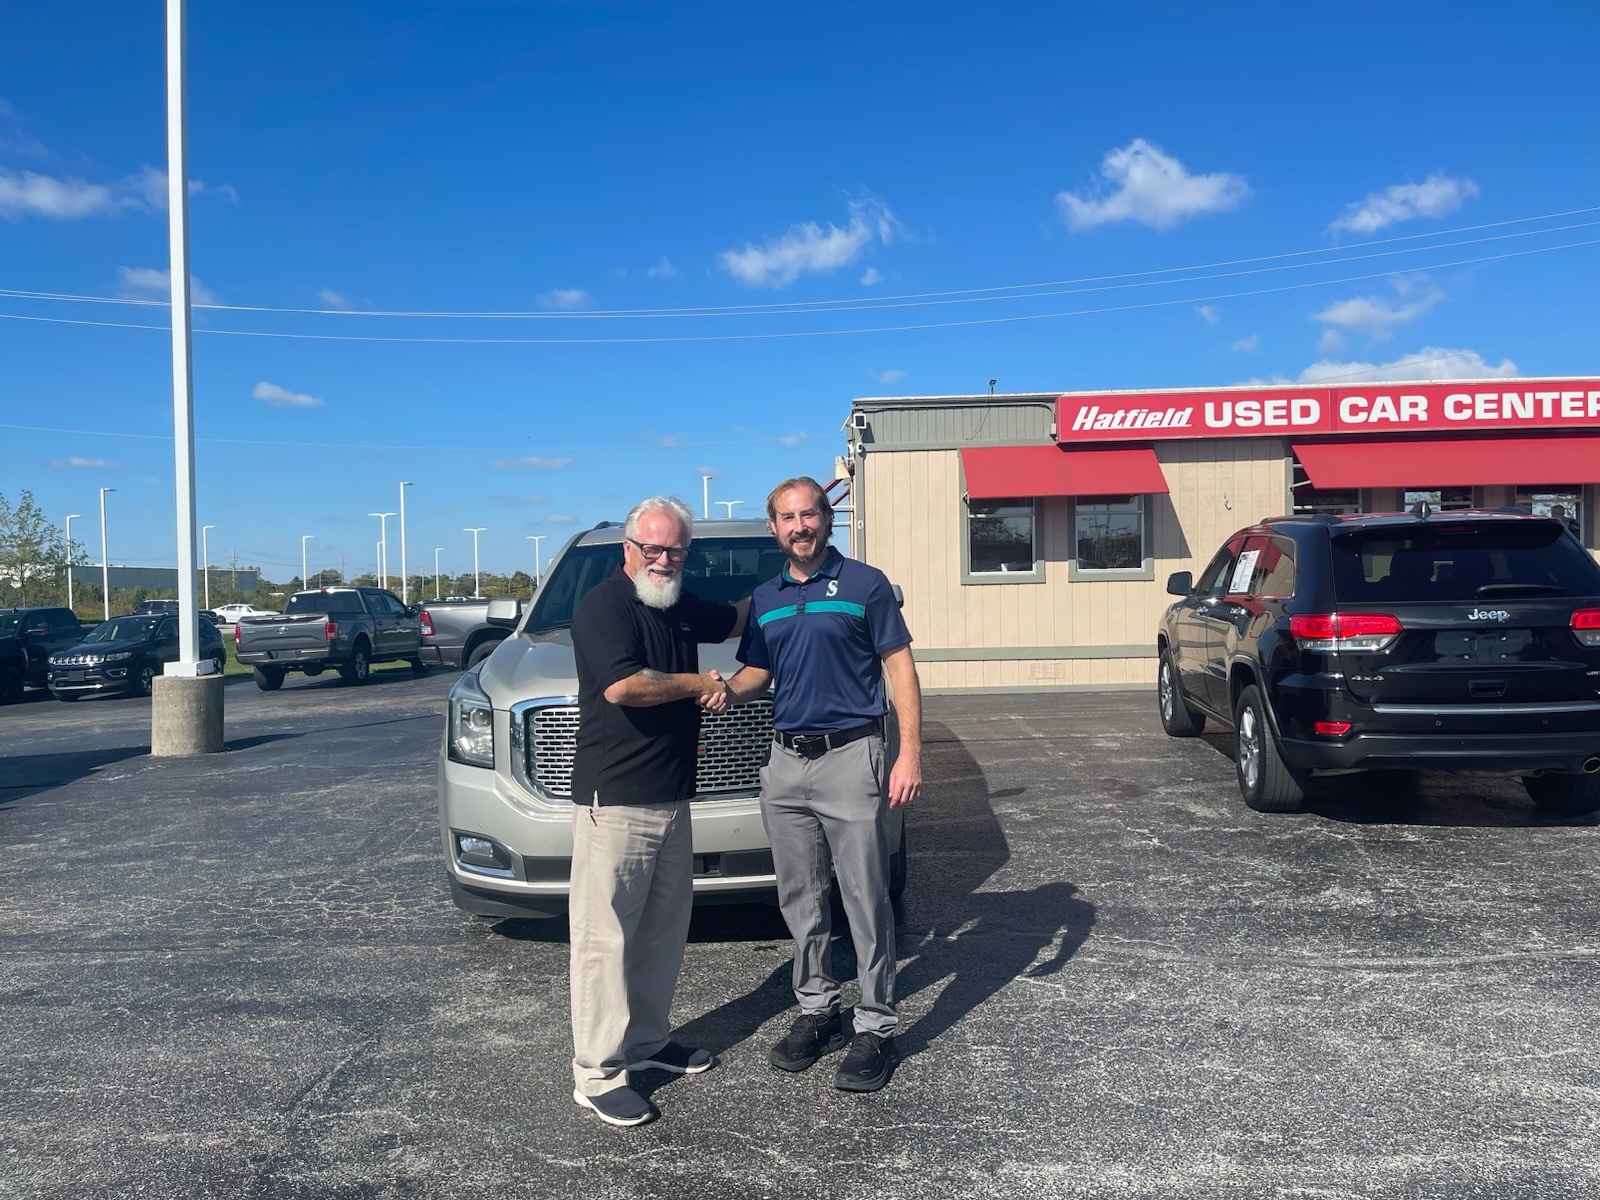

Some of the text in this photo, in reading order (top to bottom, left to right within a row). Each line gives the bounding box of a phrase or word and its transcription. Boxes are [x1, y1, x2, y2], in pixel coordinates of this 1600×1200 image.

[1072, 405, 1193, 432] Hatfield
[1204, 398, 1321, 426] USED
[1339, 394, 1428, 423] CAR
[1467, 608, 1511, 623] Jeep
[1351, 674, 1385, 682] 4x4
